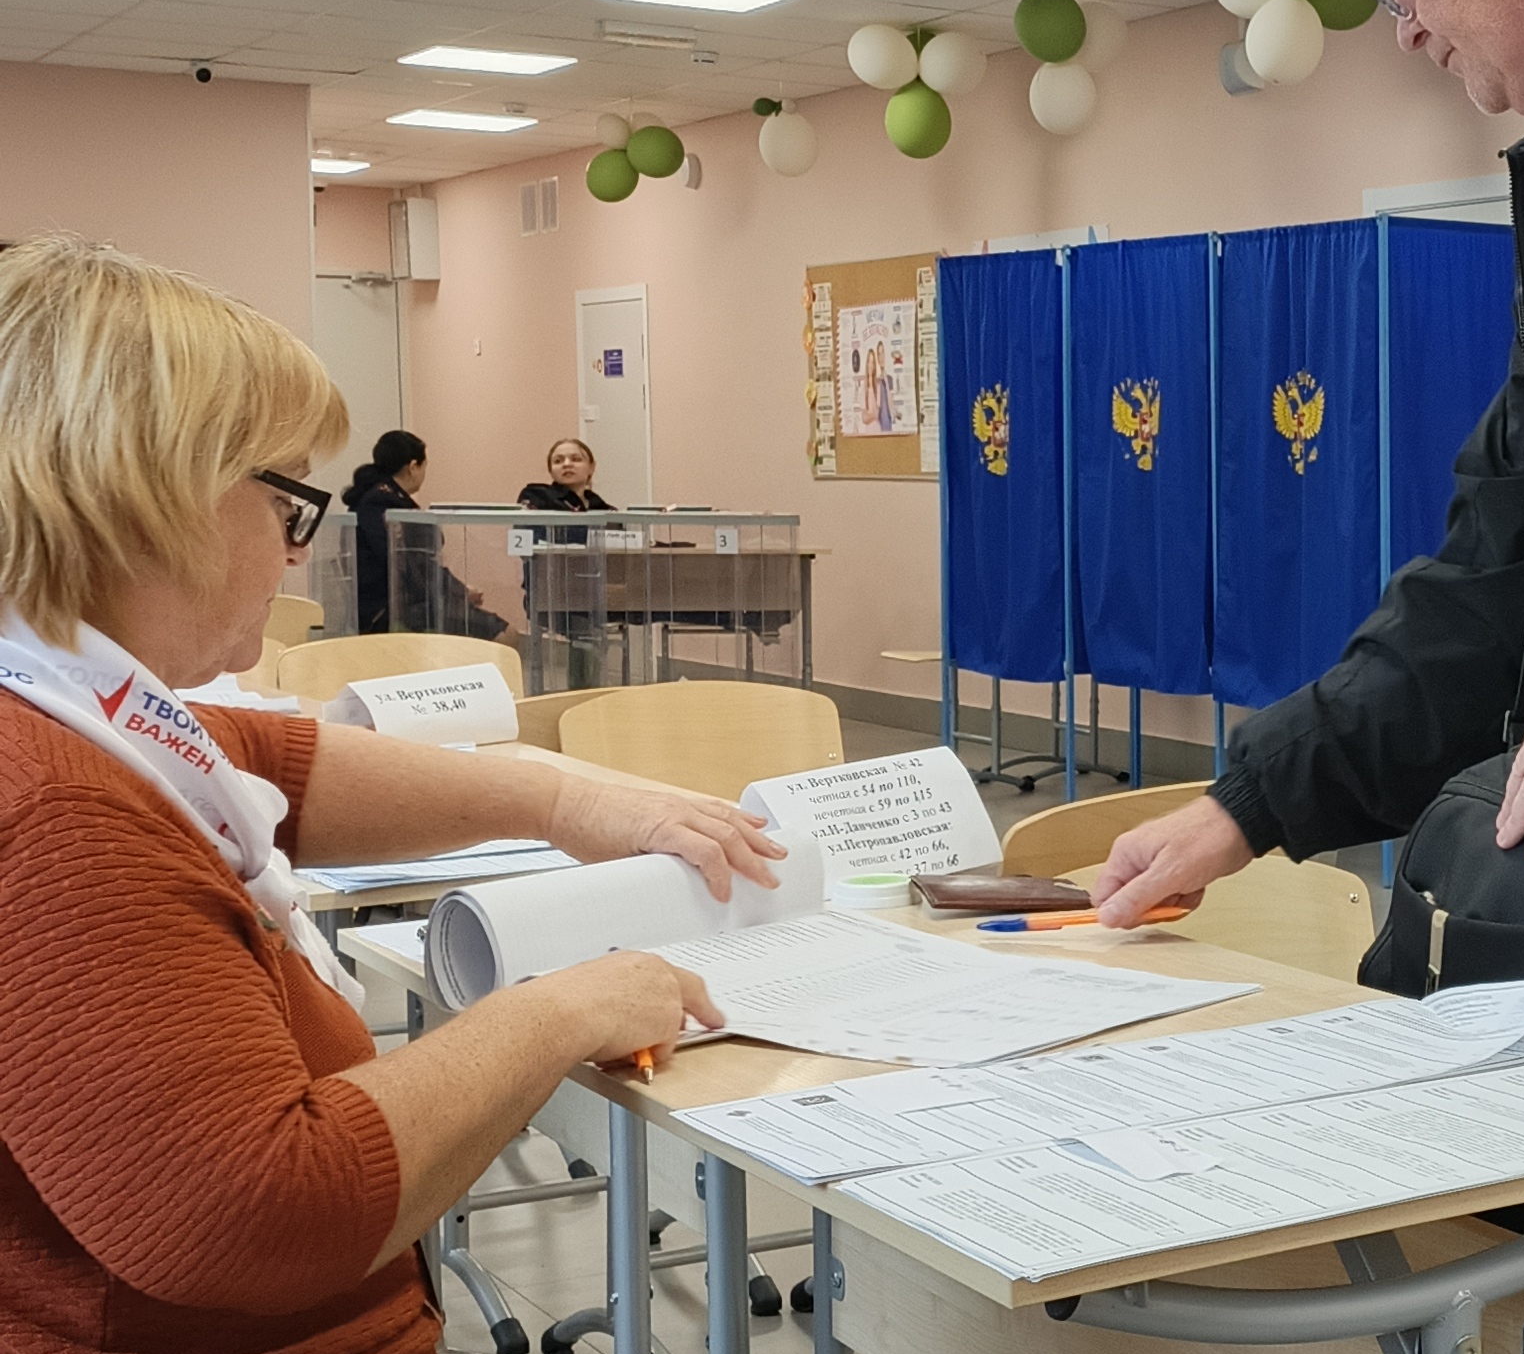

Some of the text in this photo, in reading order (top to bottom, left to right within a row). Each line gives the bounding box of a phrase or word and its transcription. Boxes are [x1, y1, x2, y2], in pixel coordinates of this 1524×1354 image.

[514, 535, 523, 549] 2
[719, 534, 727, 548] 3
[397, 680, 485, 701] Вертковская
[124, 713, 216, 775] ВАЖЕН
[786, 757, 924, 795] ул. Вертковская № 42
[808, 773, 922, 805] четная с 54 по 110,
[813, 787, 934, 821] нечетная с 59 по 115
[902, 813, 910, 824] с
[911, 809, 920, 821] 3
[922, 808, 937, 819] по
[938, 801, 953, 813] 43
[848, 854, 889, 869] четная
[890, 853, 897, 863] с
[898, 847, 912, 860] 42
[914, 845, 930, 857] по
[914, 861, 928, 875] 37
[930, 861, 945, 873] по
